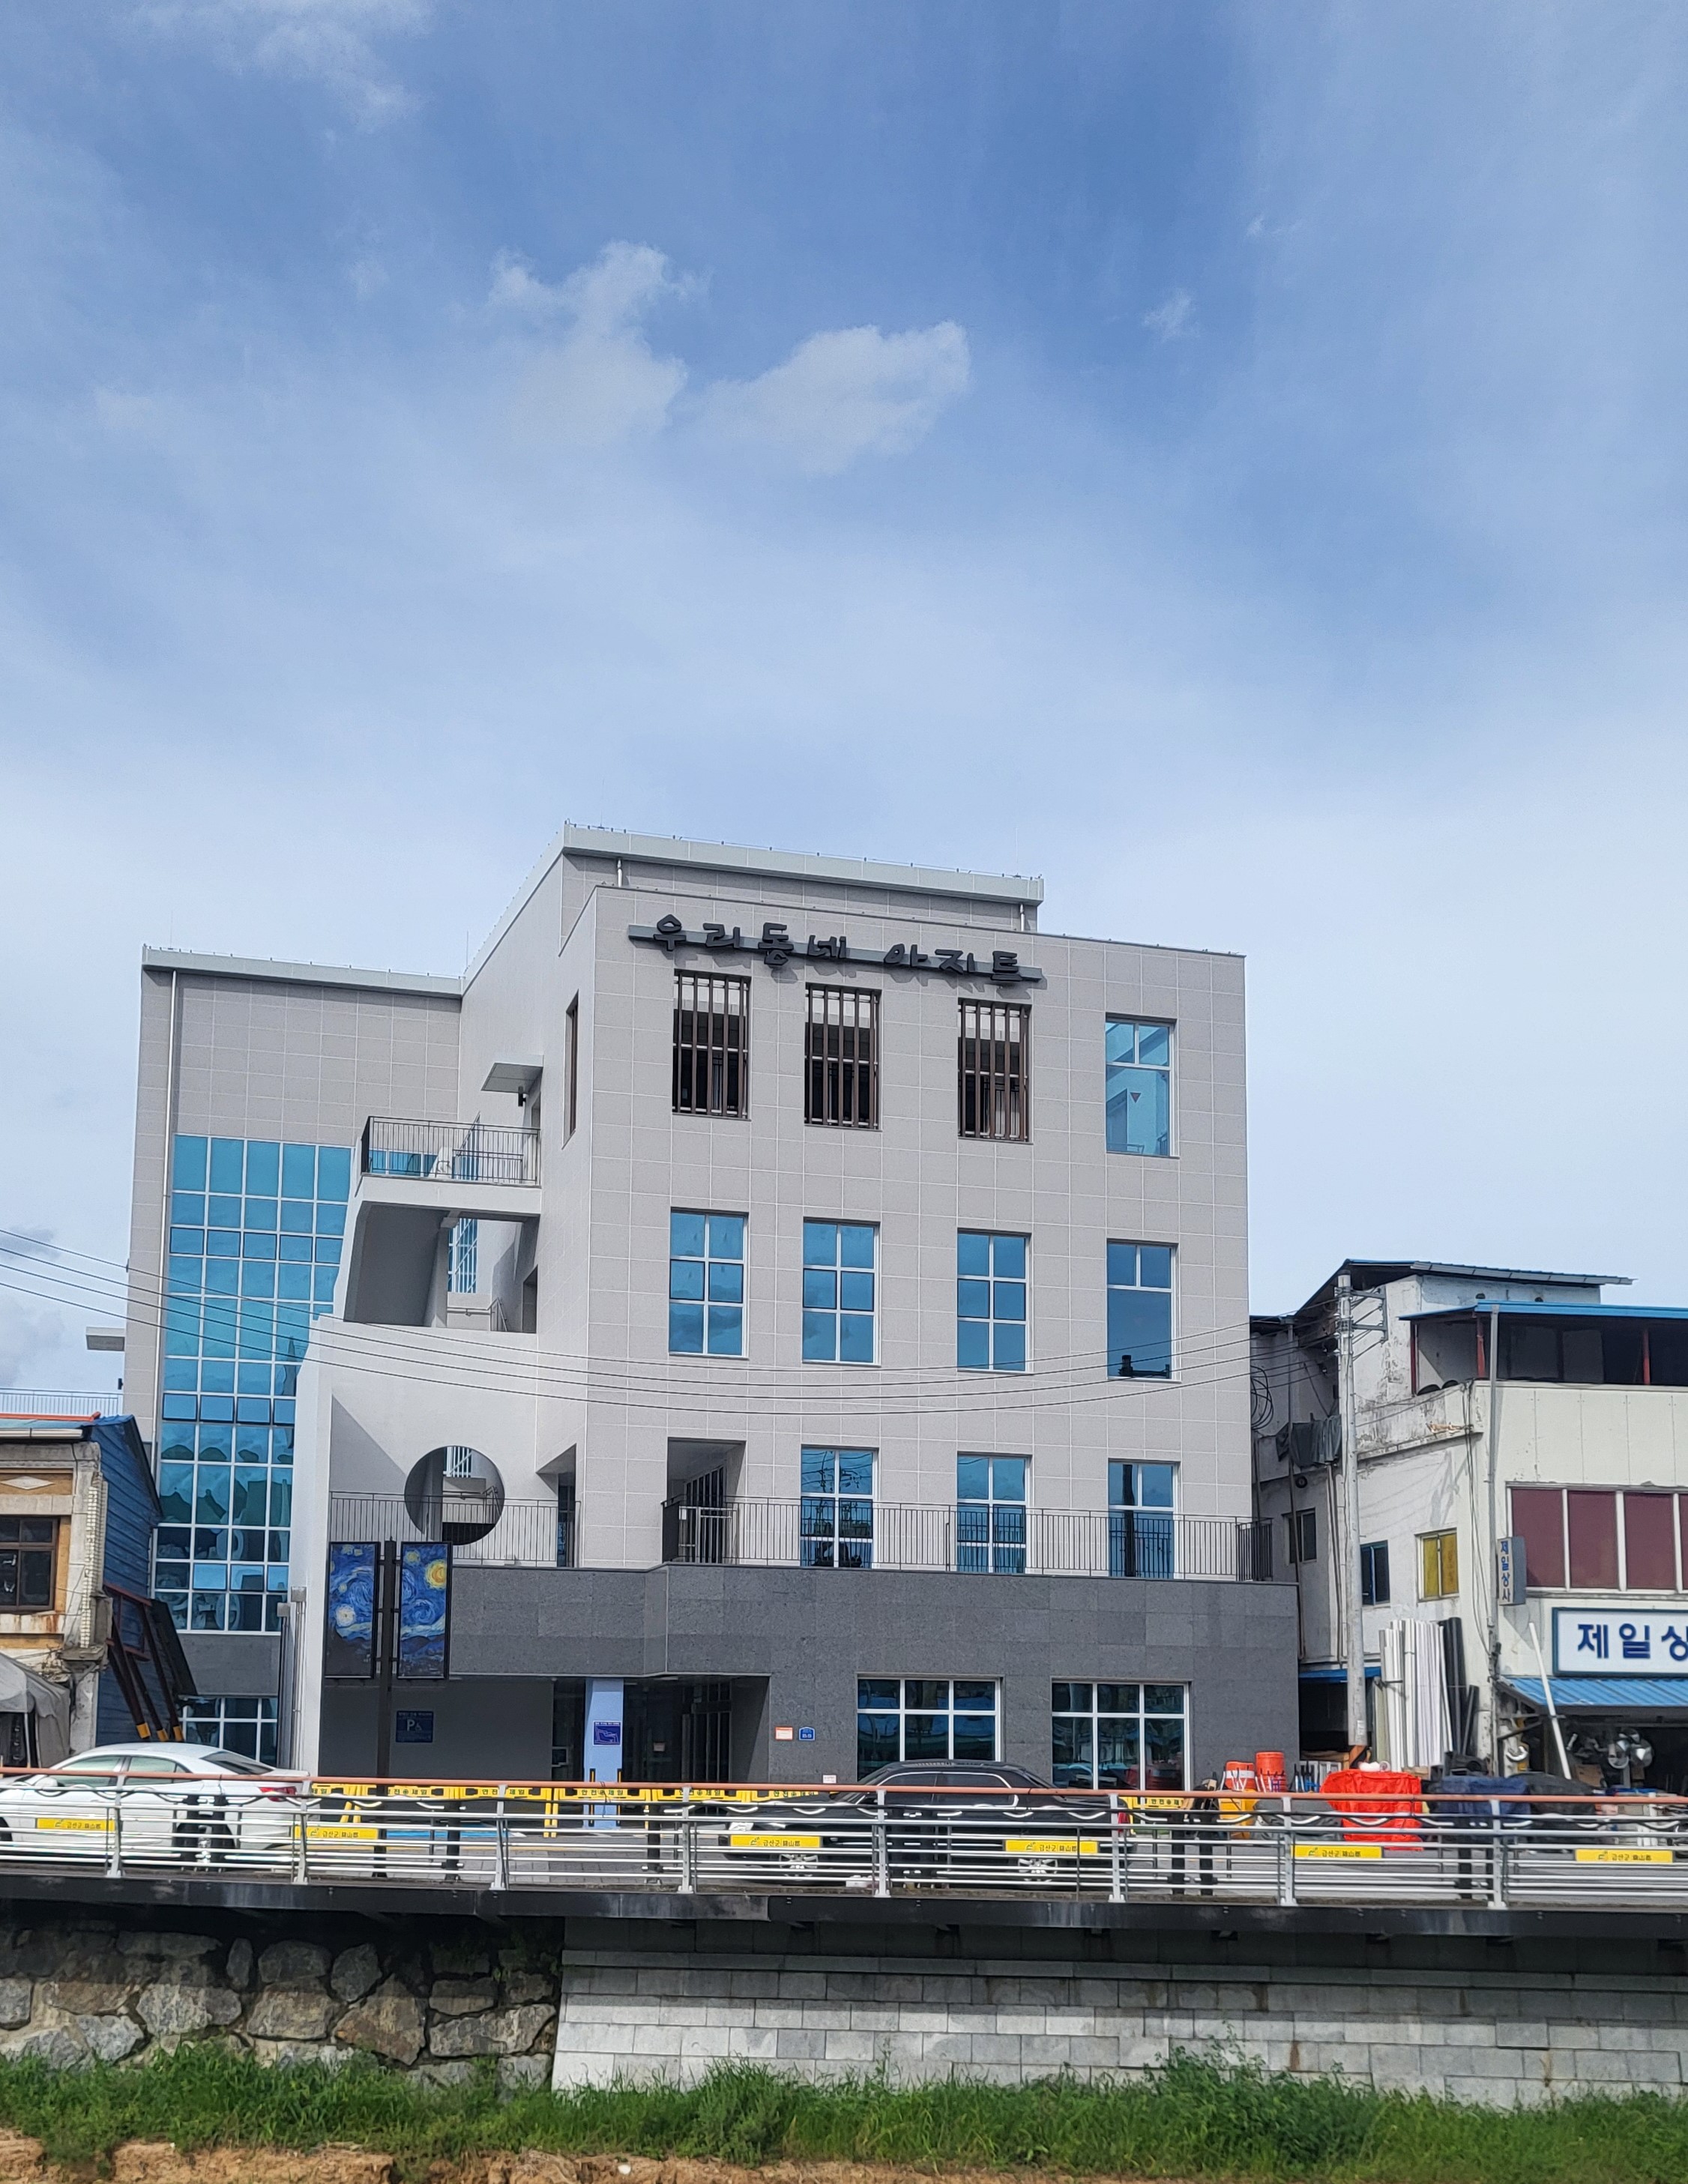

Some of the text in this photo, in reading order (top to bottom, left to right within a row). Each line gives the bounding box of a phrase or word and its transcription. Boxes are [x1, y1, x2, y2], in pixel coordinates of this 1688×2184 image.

[653, 914, 1021, 982] 우리동네 아지트
[1501, 1540, 1510, 1602] 제일상사
[1577, 1623, 1688, 1662] 제일상
